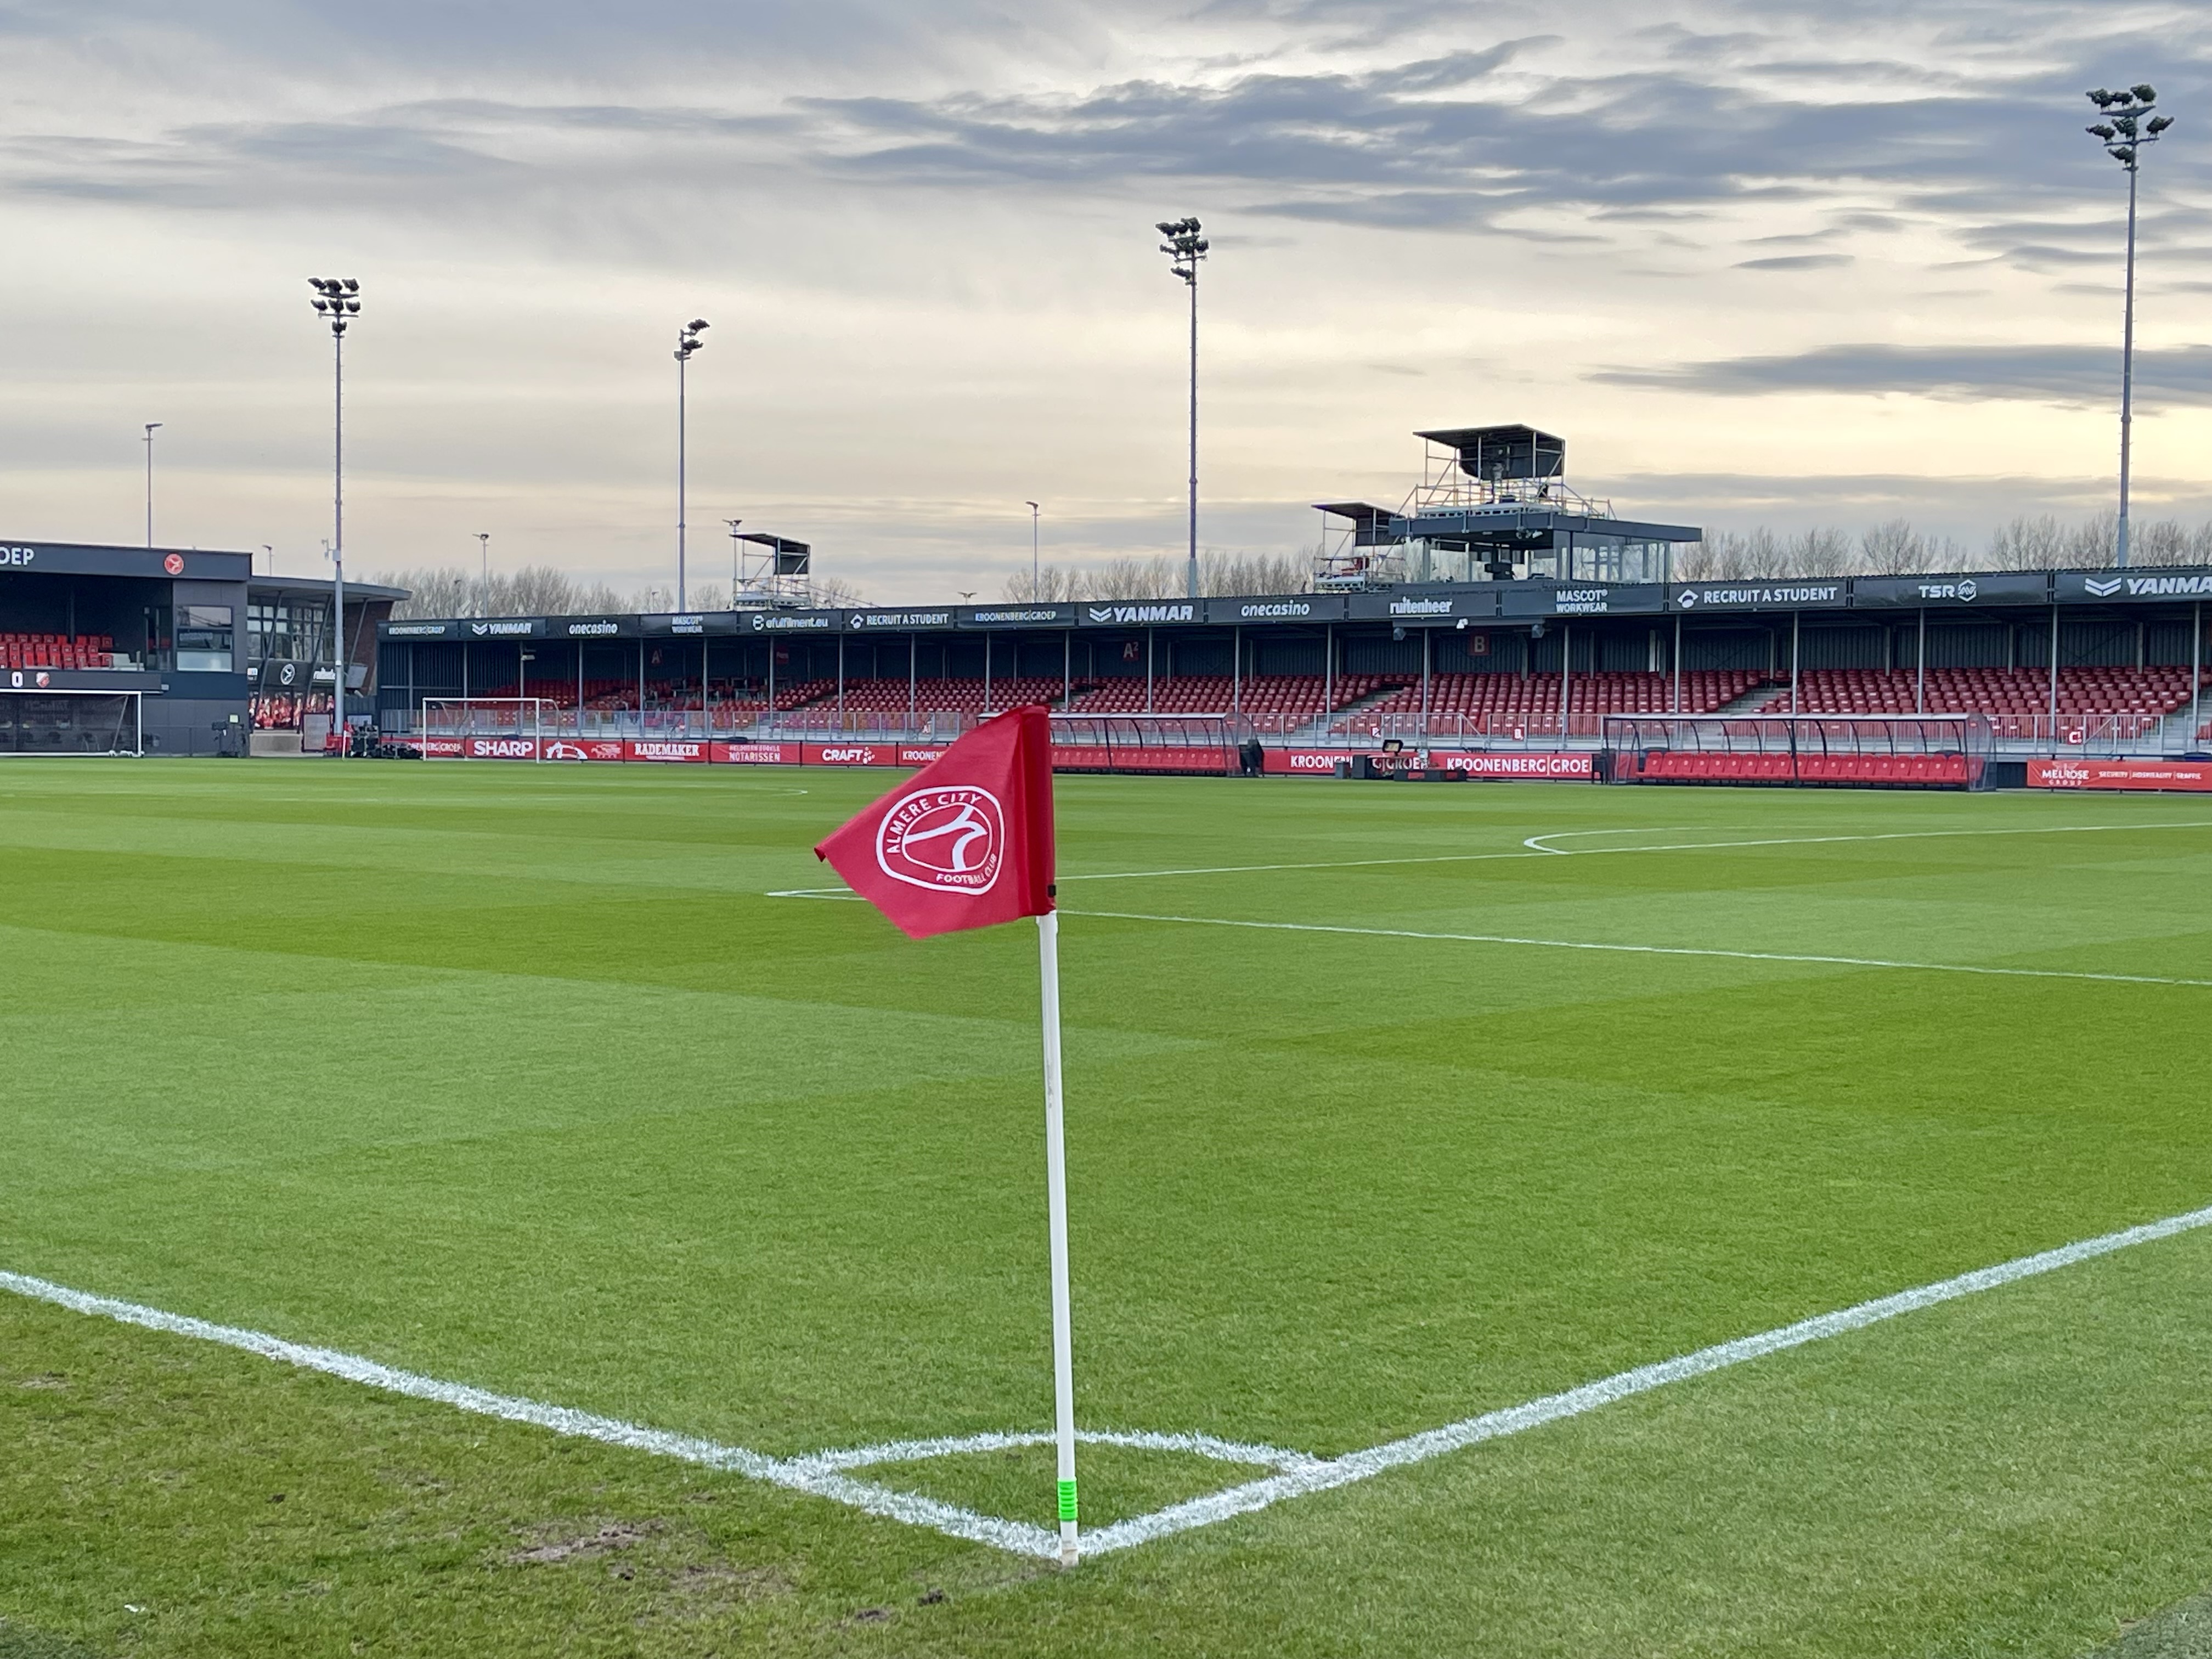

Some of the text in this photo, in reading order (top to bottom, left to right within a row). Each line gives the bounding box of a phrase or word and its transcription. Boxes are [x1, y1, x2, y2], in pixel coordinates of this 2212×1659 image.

[1704, 587, 1837, 603] RECRUIT A STUDENT
[1918, 585, 1955, 598] TSR
[1241, 600, 1310, 617] onecasino
[1390, 596, 1453, 614] ruitenheer
[1556, 602, 1608, 613] WORKWEAR
[867, 613, 949, 625] RECRUIT A STUDENT
[1031, 611, 1056, 620] GROEP
[1114, 605, 1194, 622] YANMAR
[489, 623, 532, 634] YANMAR
[569, 620, 618, 634] onecasino
[1474, 636, 1485, 652] B
[474, 741, 533, 756] SHARP
[635, 743, 699, 755] RADEMAKER
[822, 749, 863, 761] CRAFT
[729, 753, 780, 763] NOTARISSEN
[1447, 757, 1593, 772] KROONENBERG GROE
[2041, 769, 2089, 780] MELROSE
[887, 792, 981, 854] ALMERE CITY
[936, 873, 986, 885] FOOTBALL
